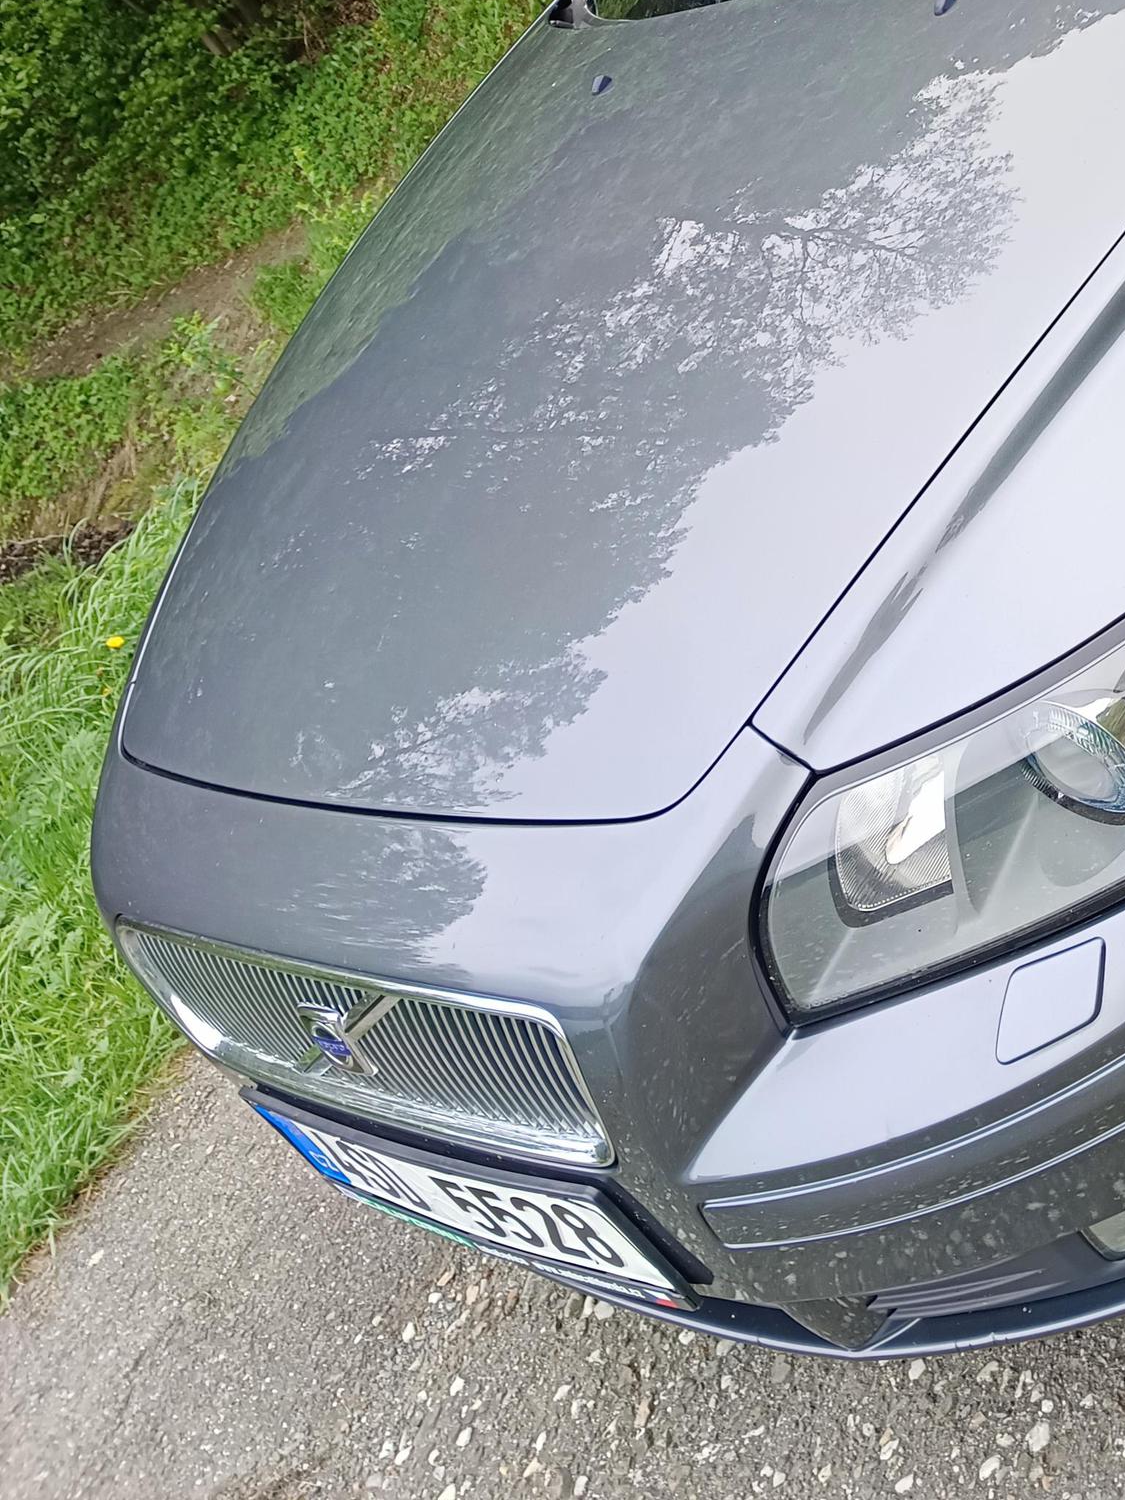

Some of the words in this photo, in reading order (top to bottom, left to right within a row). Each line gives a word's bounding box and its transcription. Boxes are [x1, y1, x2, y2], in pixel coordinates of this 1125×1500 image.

[309, 1150, 340, 1172] CZ
[310, 1131, 432, 1211] 4SD
[428, 1176, 624, 1267] 5528
